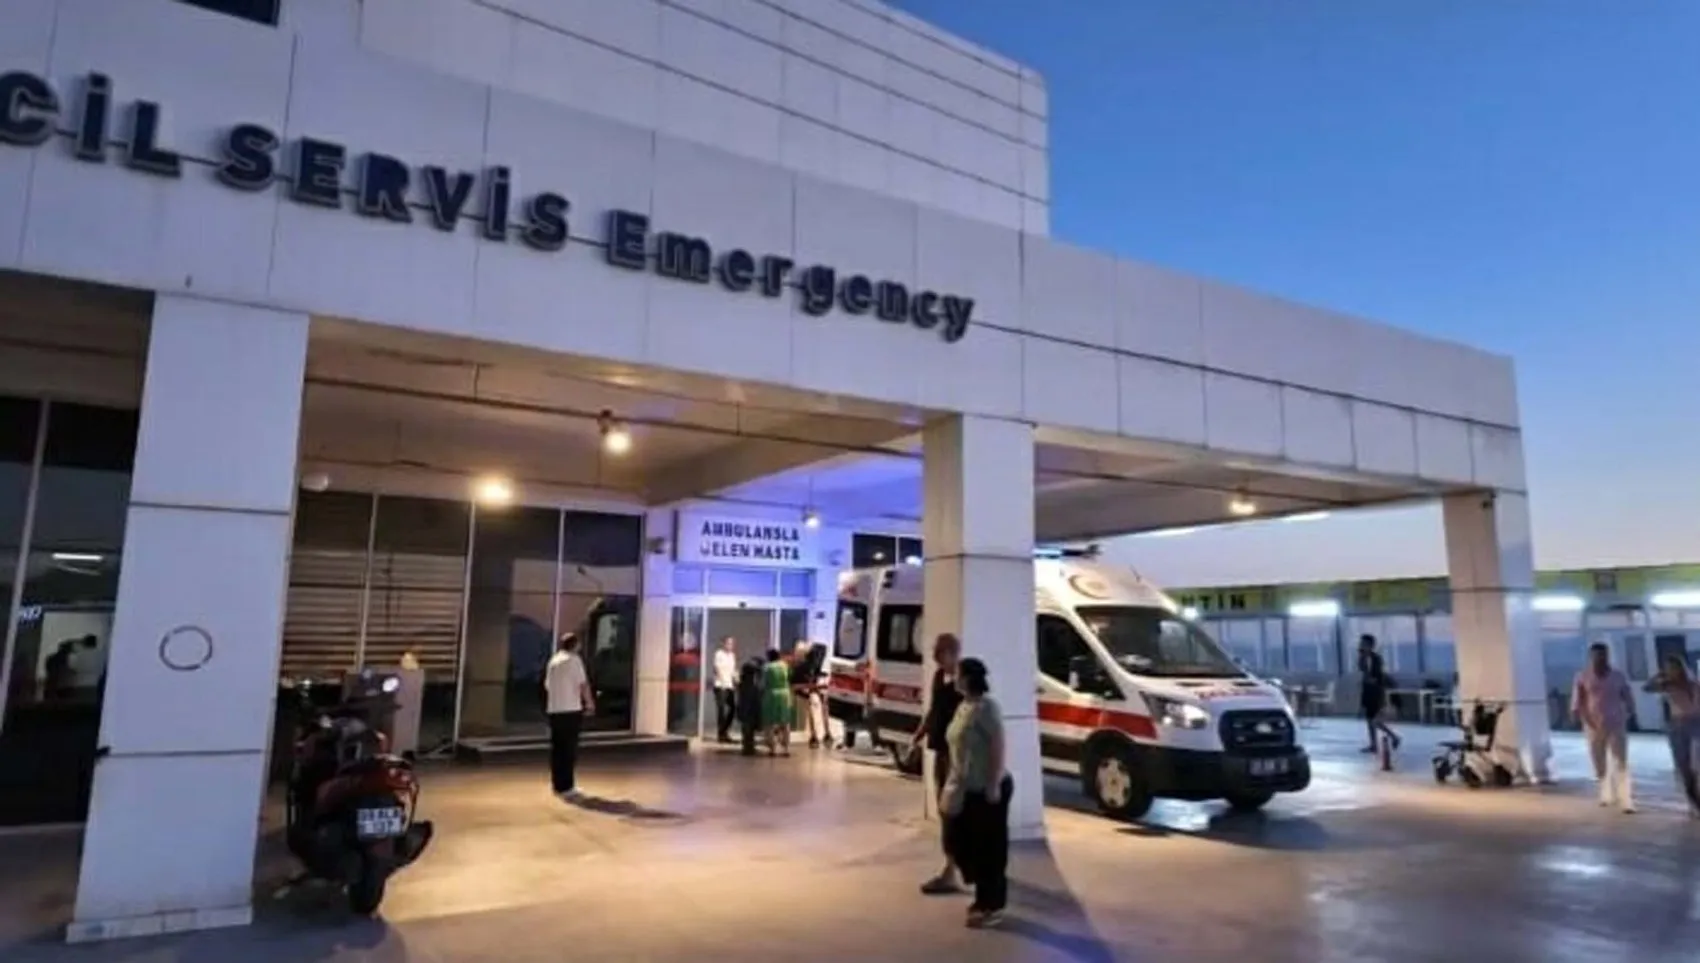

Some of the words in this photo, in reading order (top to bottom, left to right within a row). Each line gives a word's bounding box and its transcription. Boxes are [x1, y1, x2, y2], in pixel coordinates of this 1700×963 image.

[217, 124, 571, 251] SERVİS
[604, 208, 975, 343] Emergency
[701, 520, 800, 541] AMBULANSLA
[754, 544, 800, 560] HASTA
